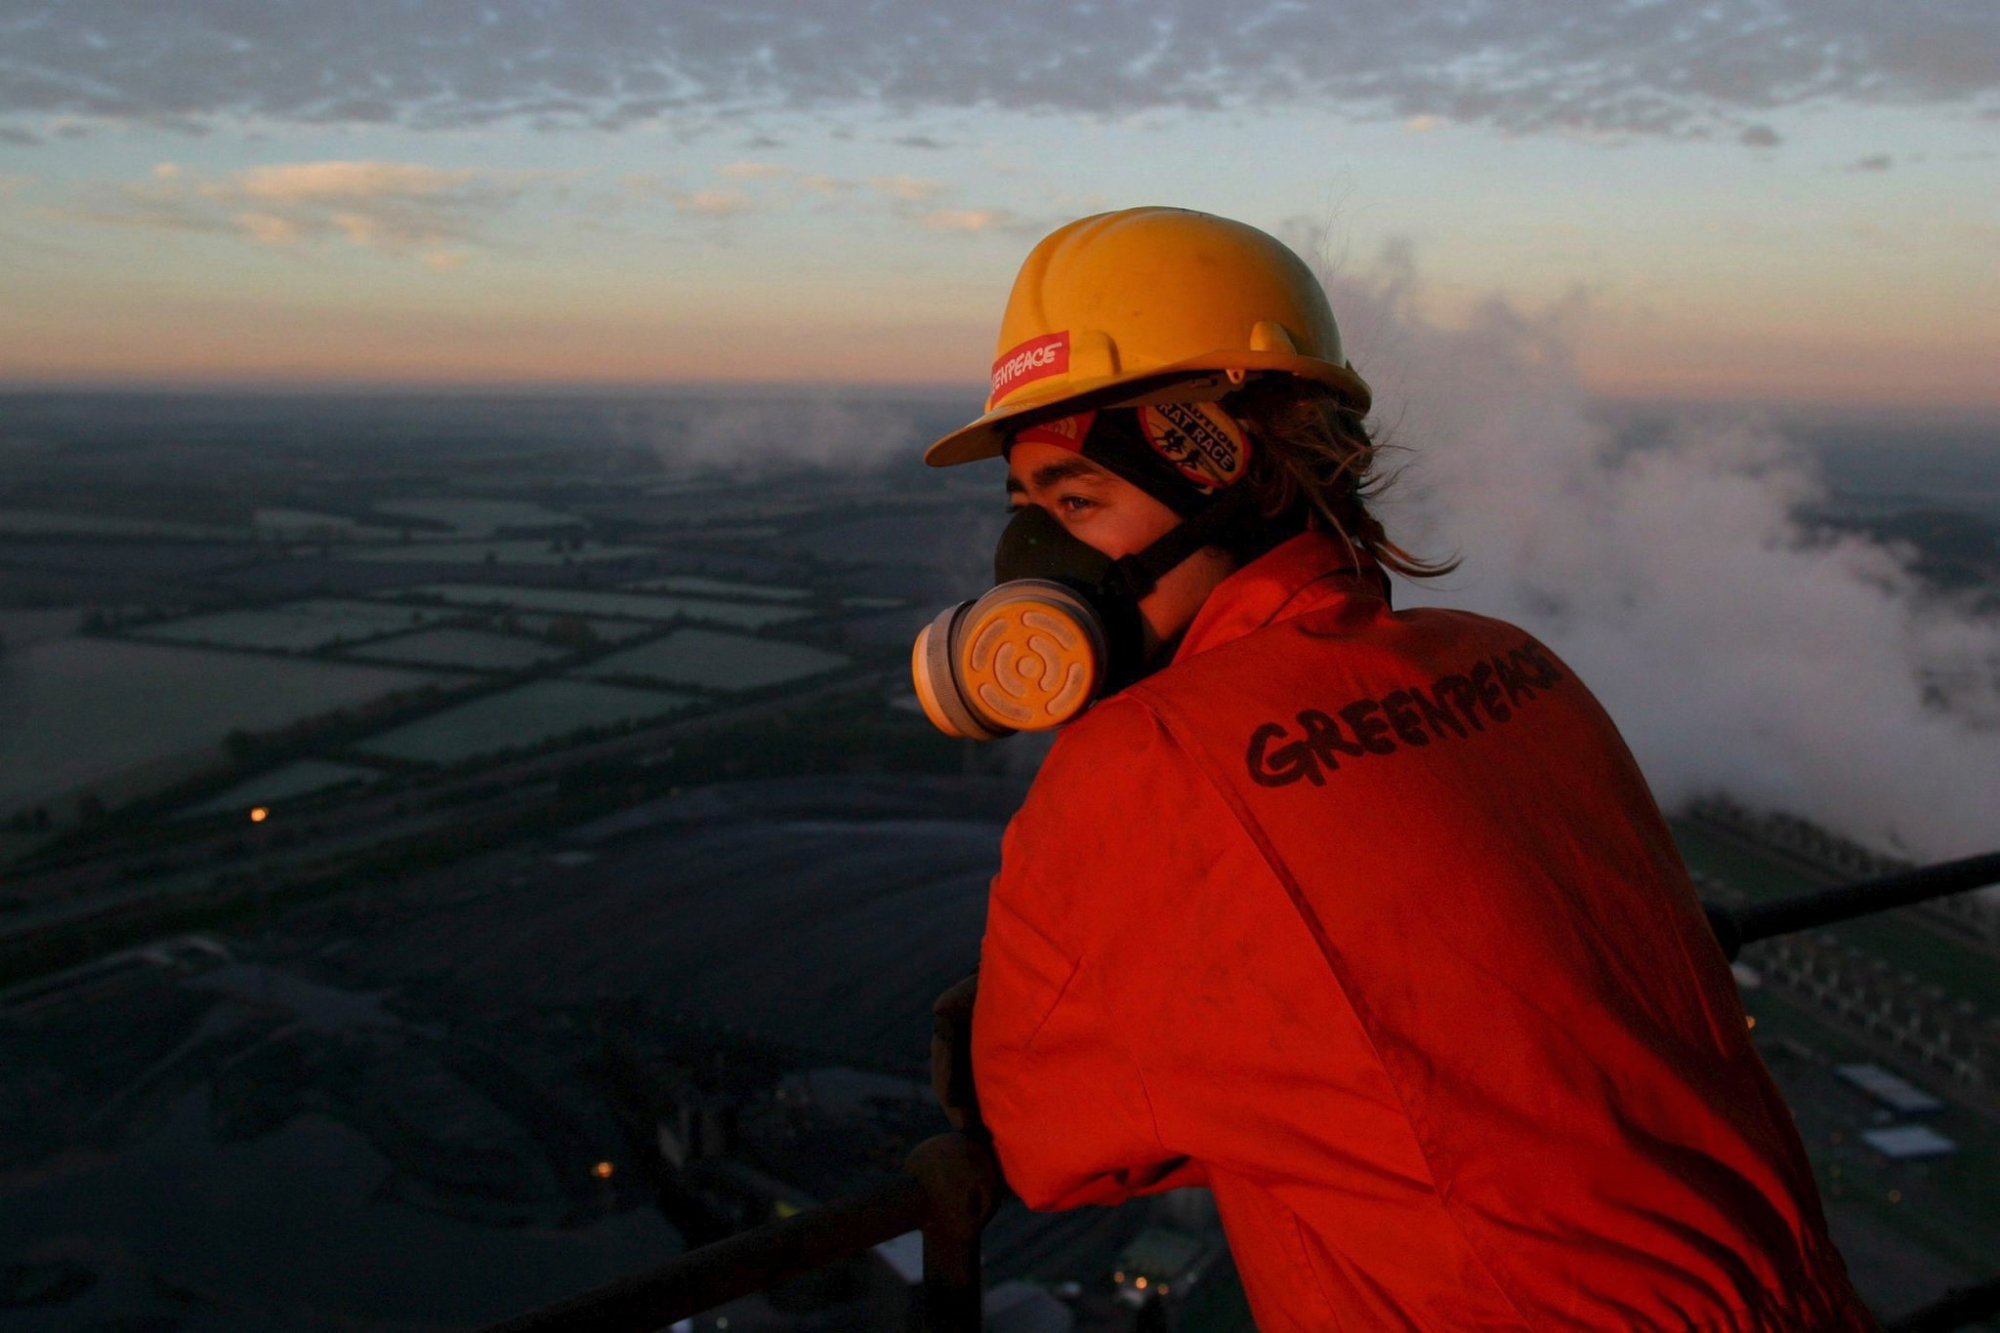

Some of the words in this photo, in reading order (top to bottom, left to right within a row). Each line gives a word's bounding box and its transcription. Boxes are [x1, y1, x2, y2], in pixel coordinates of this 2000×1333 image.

[1160, 403, 1192, 429] RAT
[1191, 428, 1234, 470] RACE
[1180, 402, 1238, 454] AUTION
